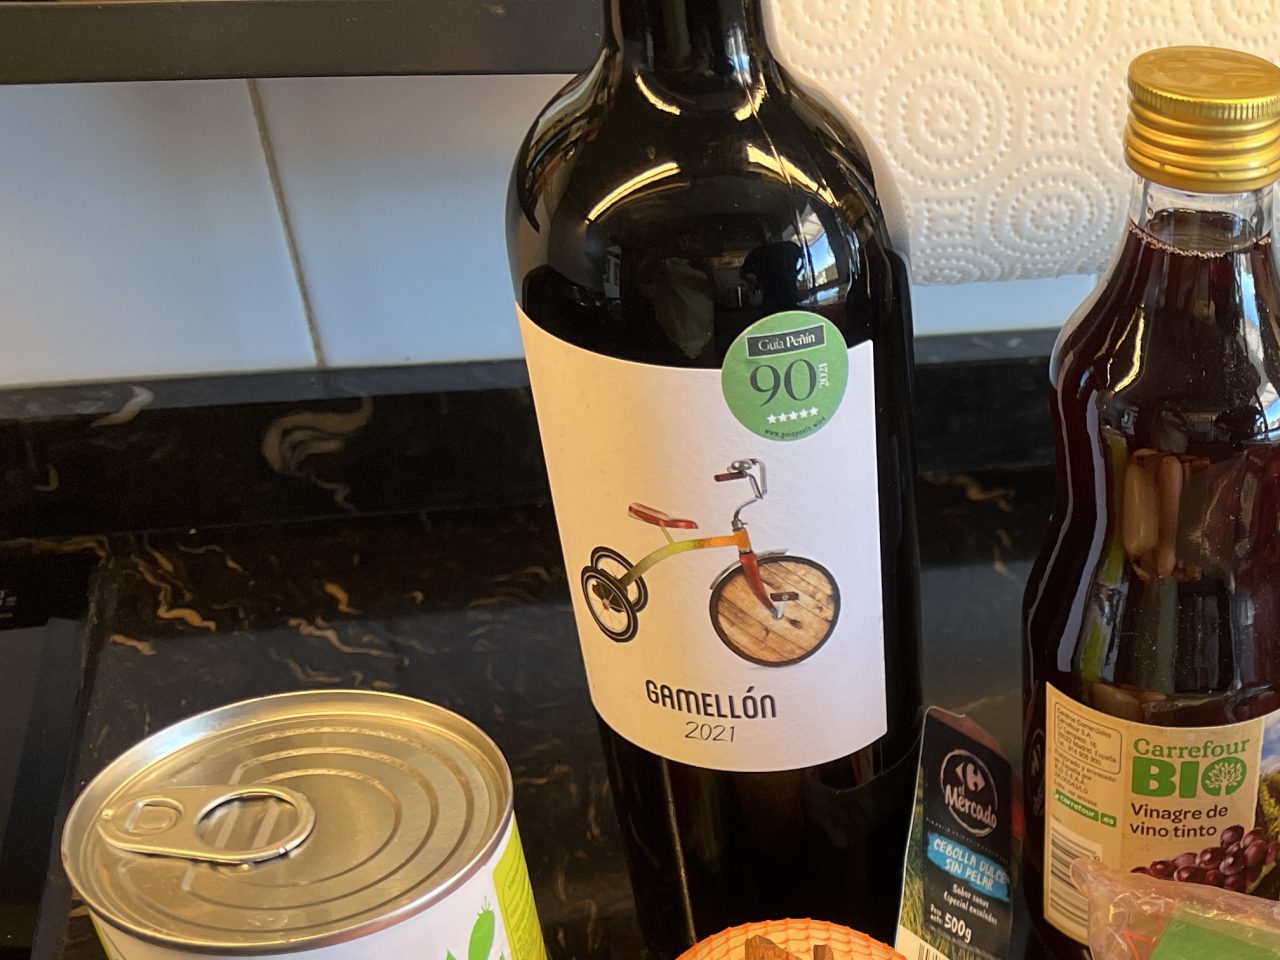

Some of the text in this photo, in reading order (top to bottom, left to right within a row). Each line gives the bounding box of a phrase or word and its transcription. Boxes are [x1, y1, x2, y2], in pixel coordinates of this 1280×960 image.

[749, 359, 817, 407] 90
[818, 363, 829, 389] 2021
[645, 679, 777, 719] GAMELLÓN
[684, 721, 736, 743] 2021
[1133, 737, 1250, 759] Carrefour
[945, 783, 997, 829] Mercado
[1130, 802, 1229, 823] Vinagre de
[1130, 822, 1217, 839] vino tinto
[934, 838, 977, 868] CEBOLLA
[980, 861, 1007, 883] DULCE
[945, 858, 994, 890] SIN PELAR
[952, 883, 972, 900] Sabor
